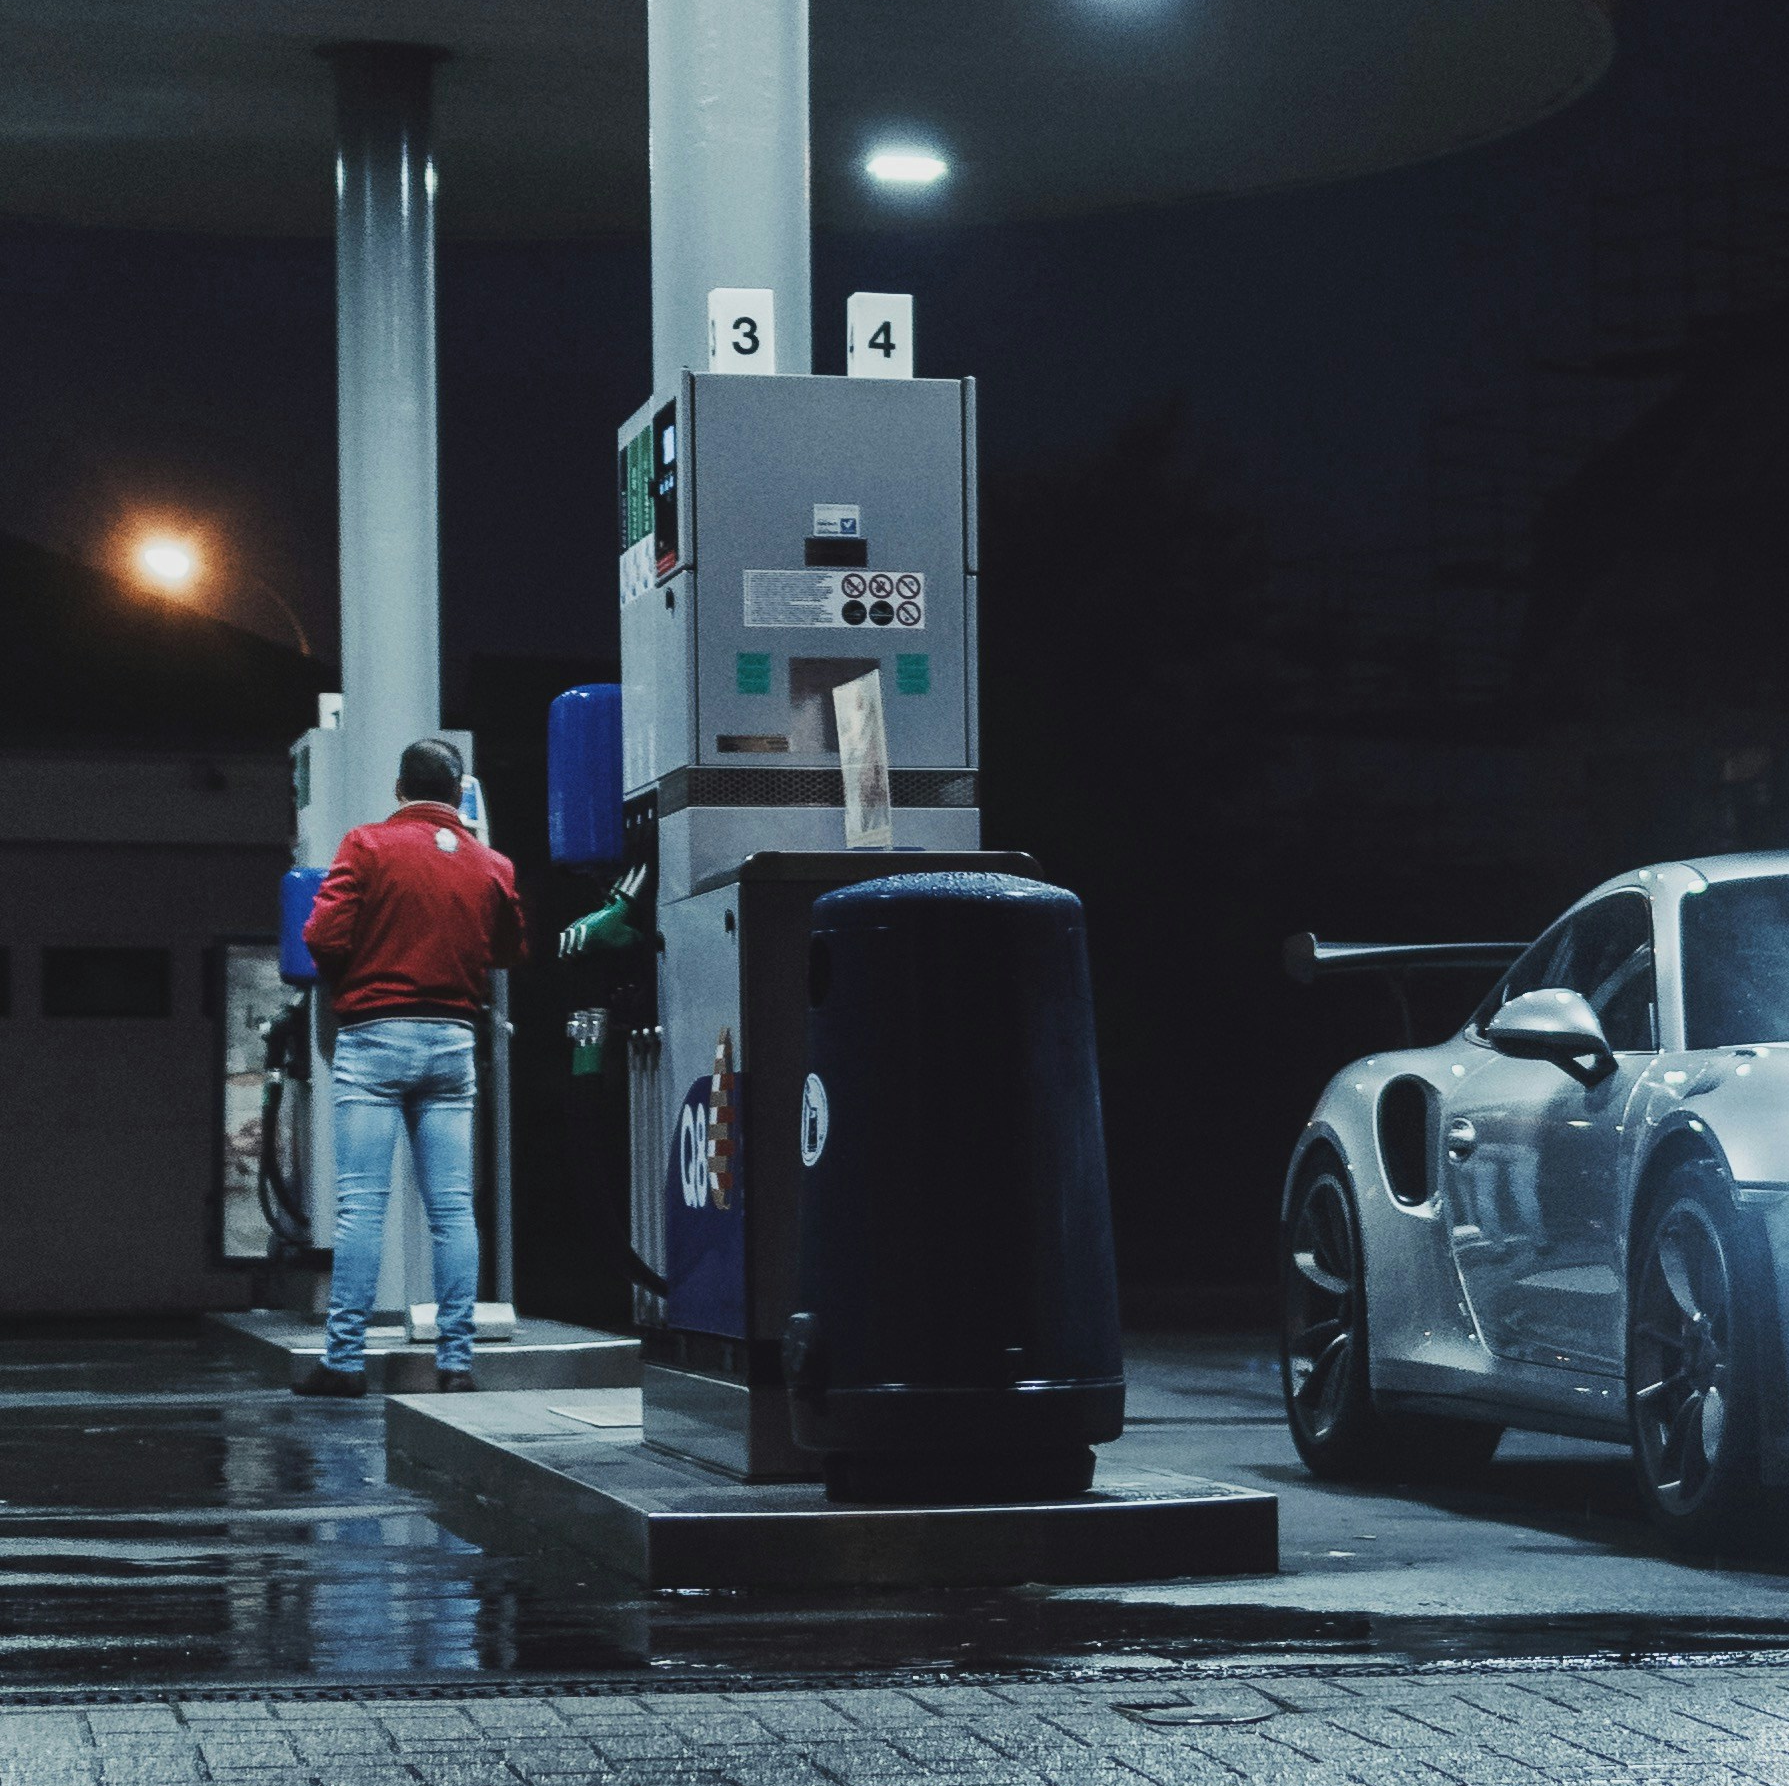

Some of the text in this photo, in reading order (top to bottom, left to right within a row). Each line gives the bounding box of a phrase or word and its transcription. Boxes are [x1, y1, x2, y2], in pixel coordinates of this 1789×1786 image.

[732, 316, 760, 355] 3
[868, 320, 896, 359] 4
[680, 1102, 708, 1208] Q8
